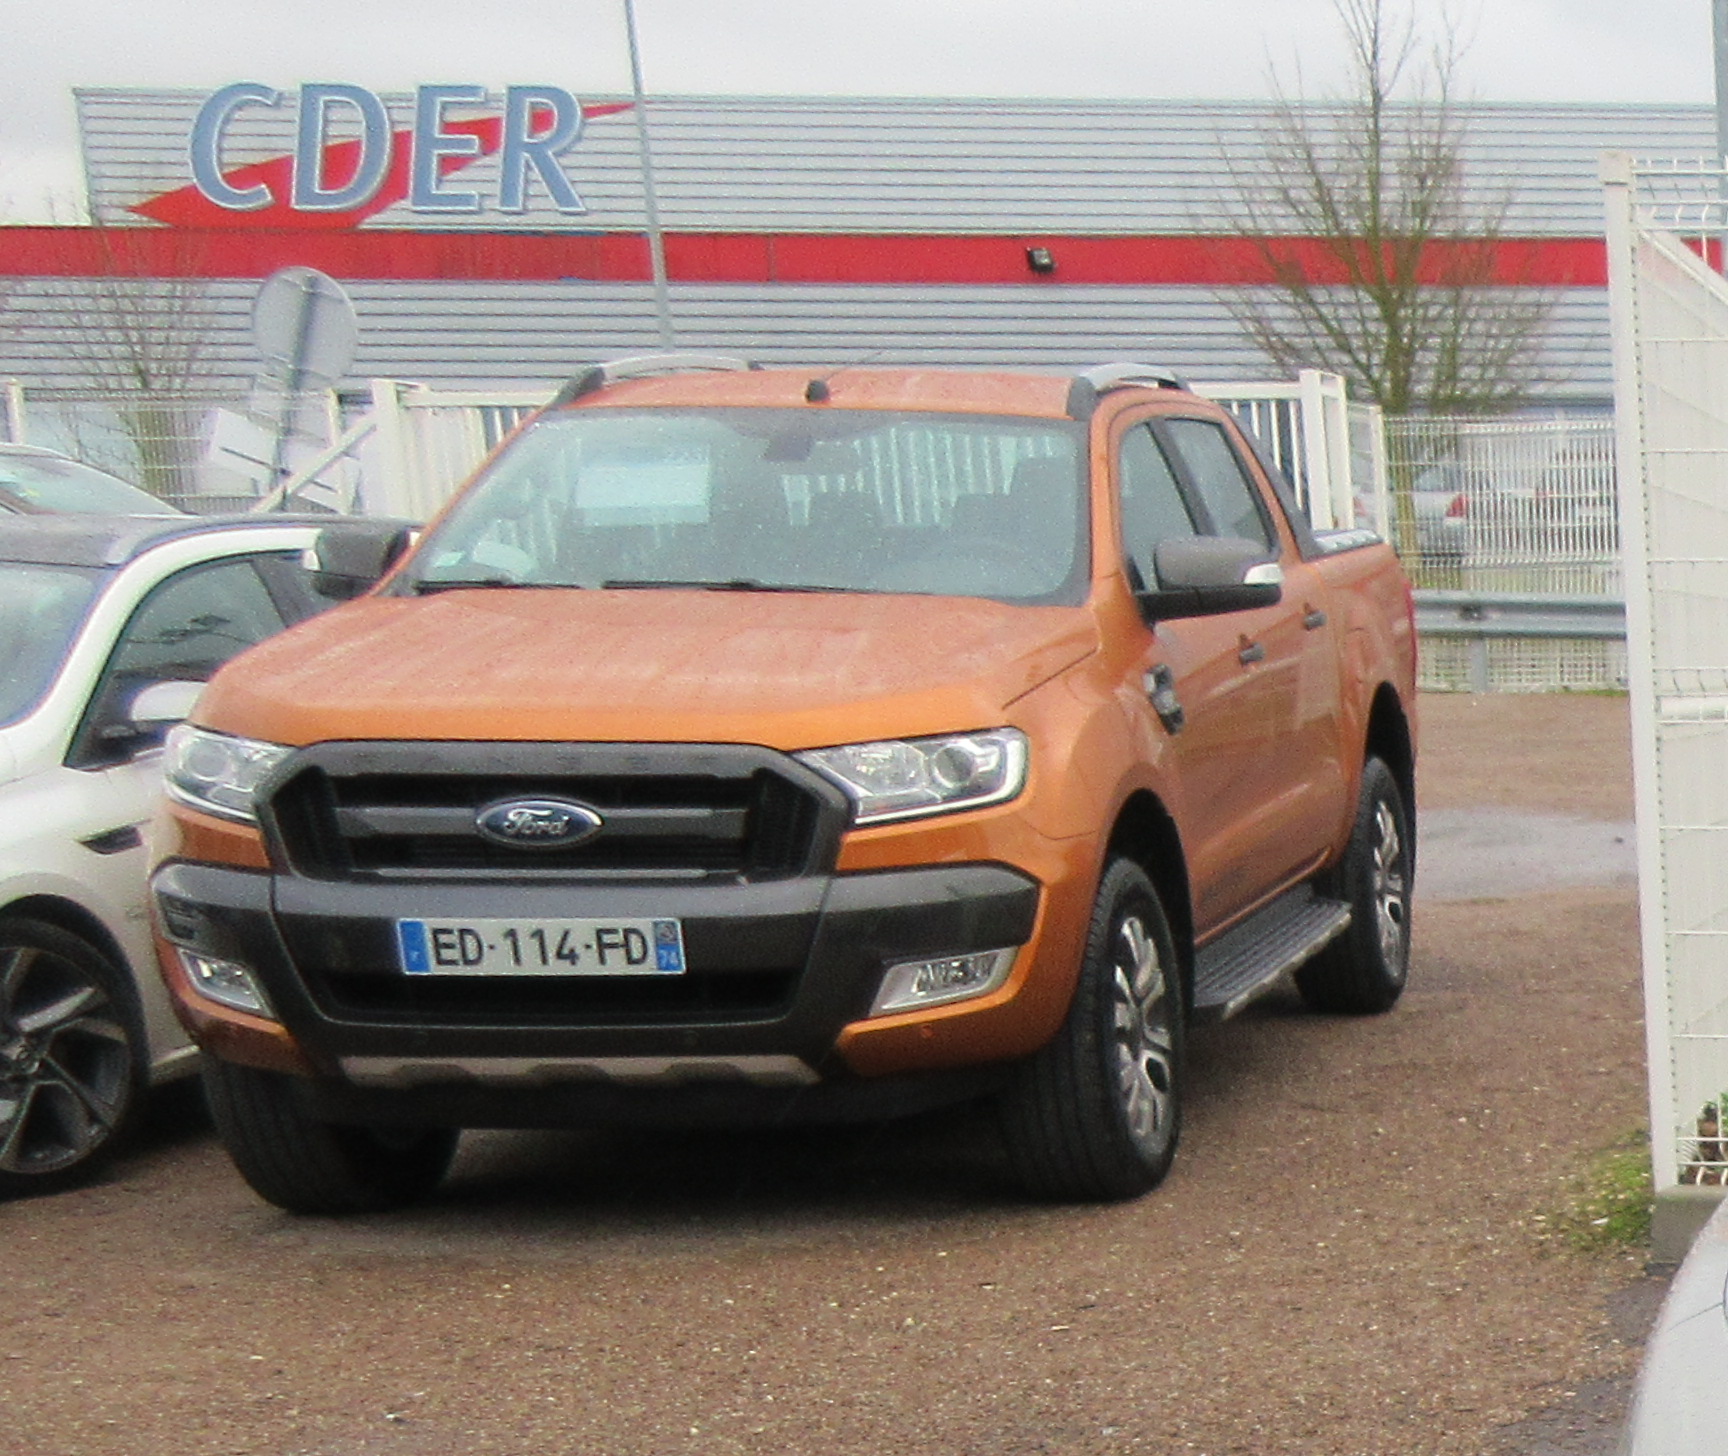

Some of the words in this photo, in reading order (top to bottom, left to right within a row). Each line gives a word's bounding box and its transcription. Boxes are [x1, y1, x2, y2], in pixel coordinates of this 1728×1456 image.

[188, 80, 588, 213] CDER
[504, 808, 571, 835] Ford
[432, 928, 648, 967] ED-114-FD
